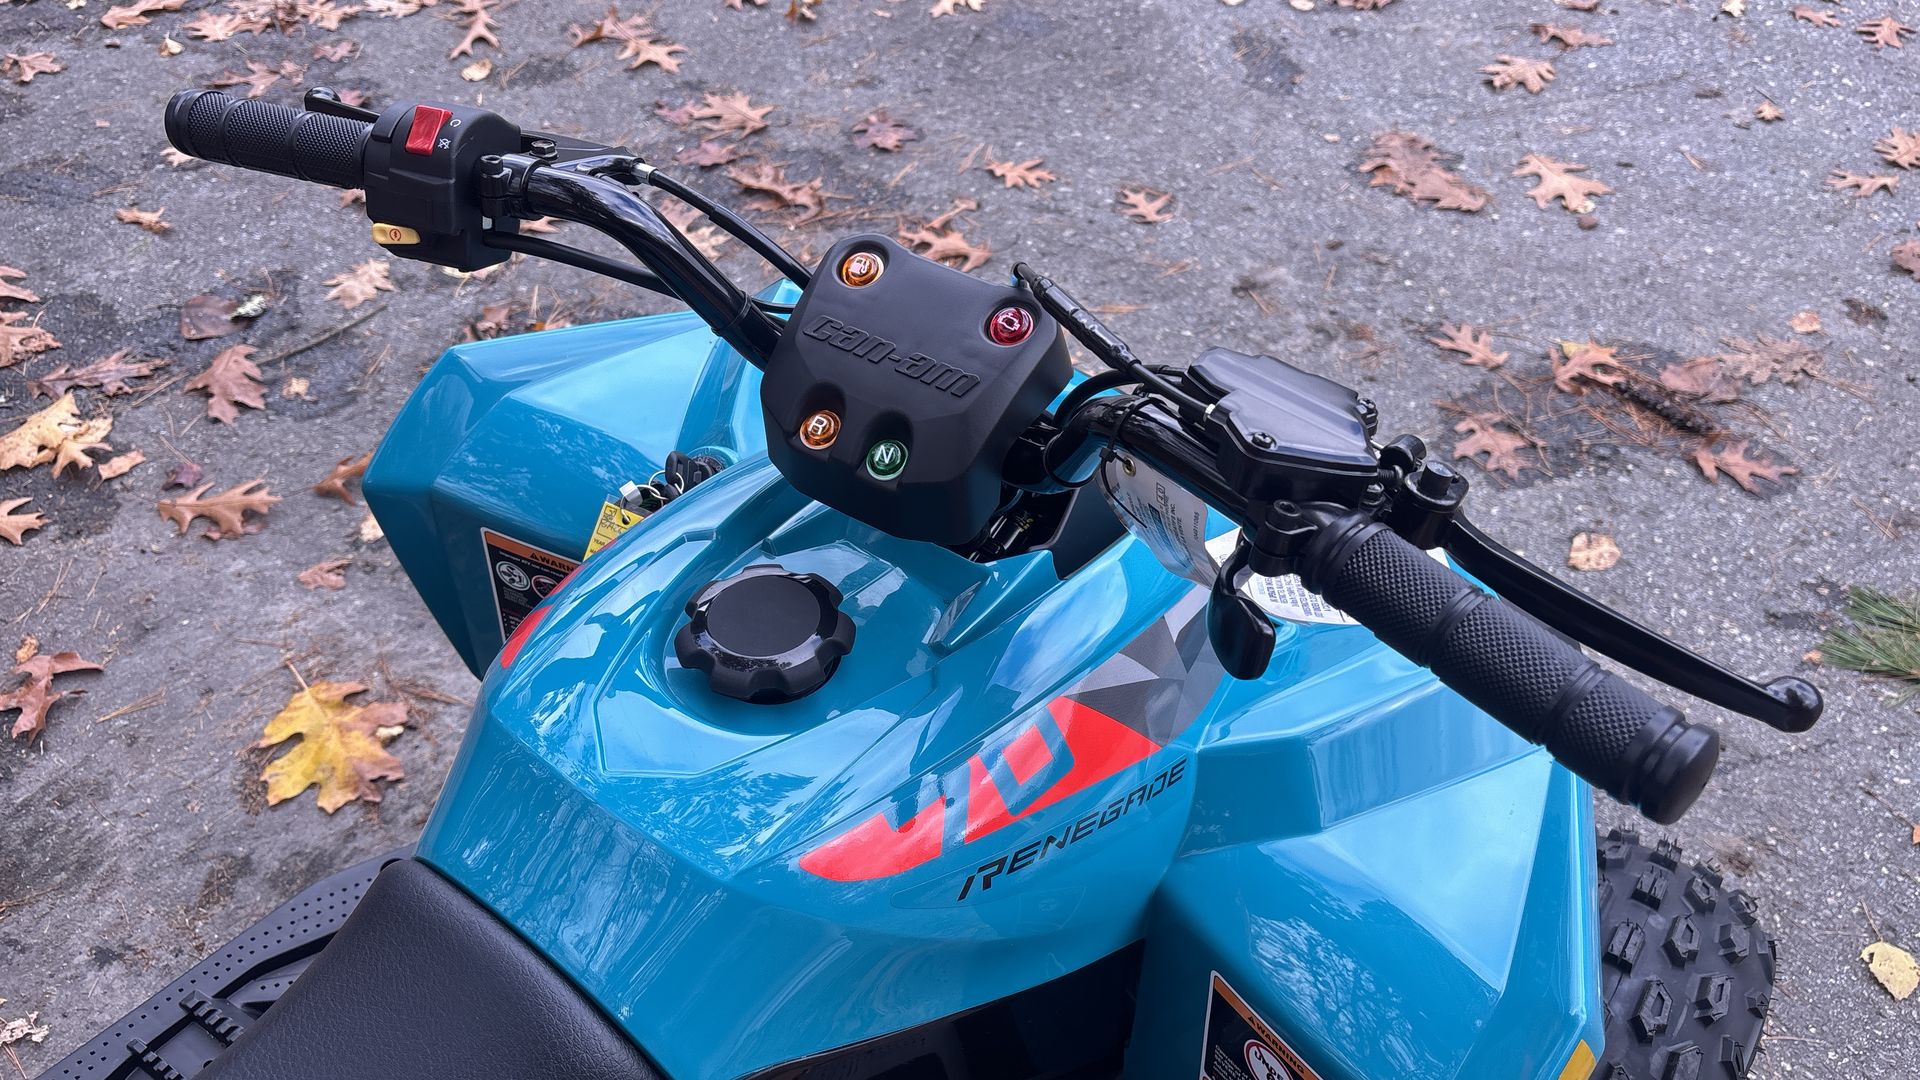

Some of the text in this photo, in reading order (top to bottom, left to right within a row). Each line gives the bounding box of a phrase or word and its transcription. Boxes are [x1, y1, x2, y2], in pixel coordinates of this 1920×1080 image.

[802, 315, 981, 397] can-am
[808, 415, 827, 436] R
[875, 444, 896, 464] N
[957, 758, 1188, 902] RENEGADE
[1256, 1022, 1305, 1074] WARNING
